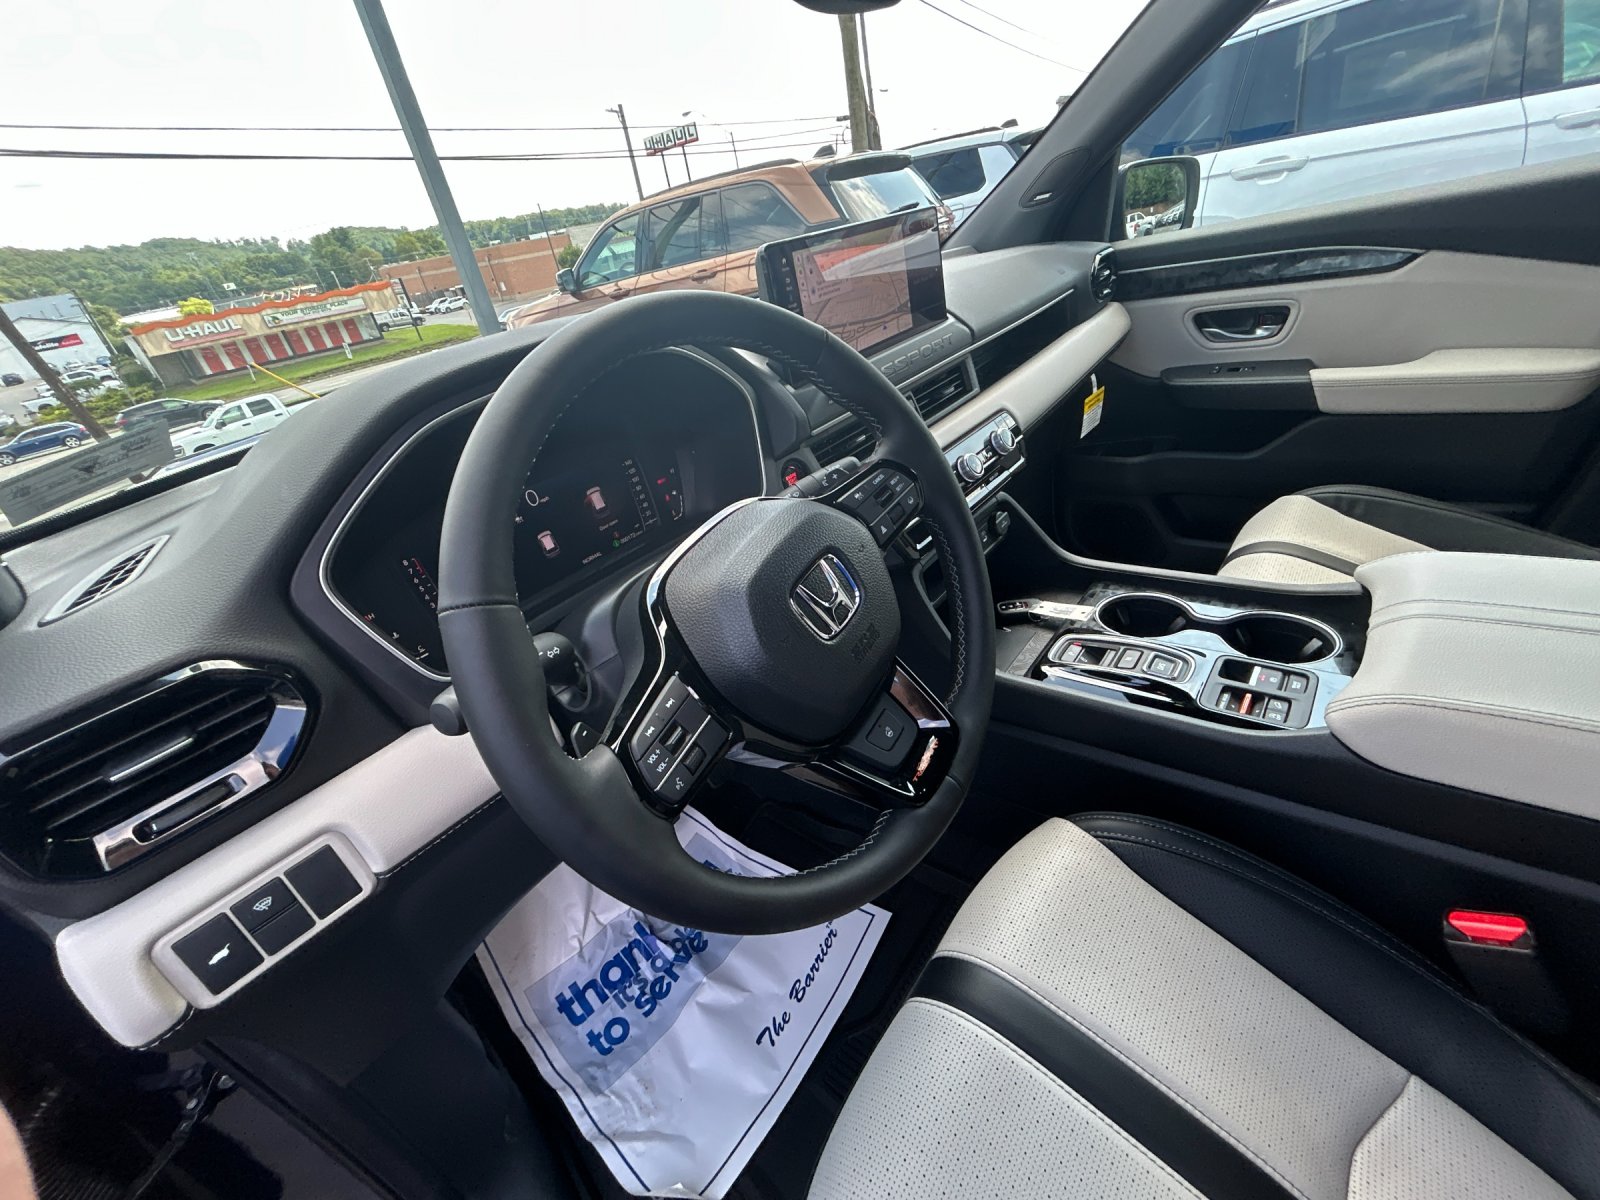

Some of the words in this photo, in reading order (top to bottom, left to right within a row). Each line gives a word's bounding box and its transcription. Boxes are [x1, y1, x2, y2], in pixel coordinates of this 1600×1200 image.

[586, 1016, 630, 1057] to
[634, 931, 709, 1018] serve
[755, 1011, 791, 1047] The
[789, 928, 838, 1003] Barrier
